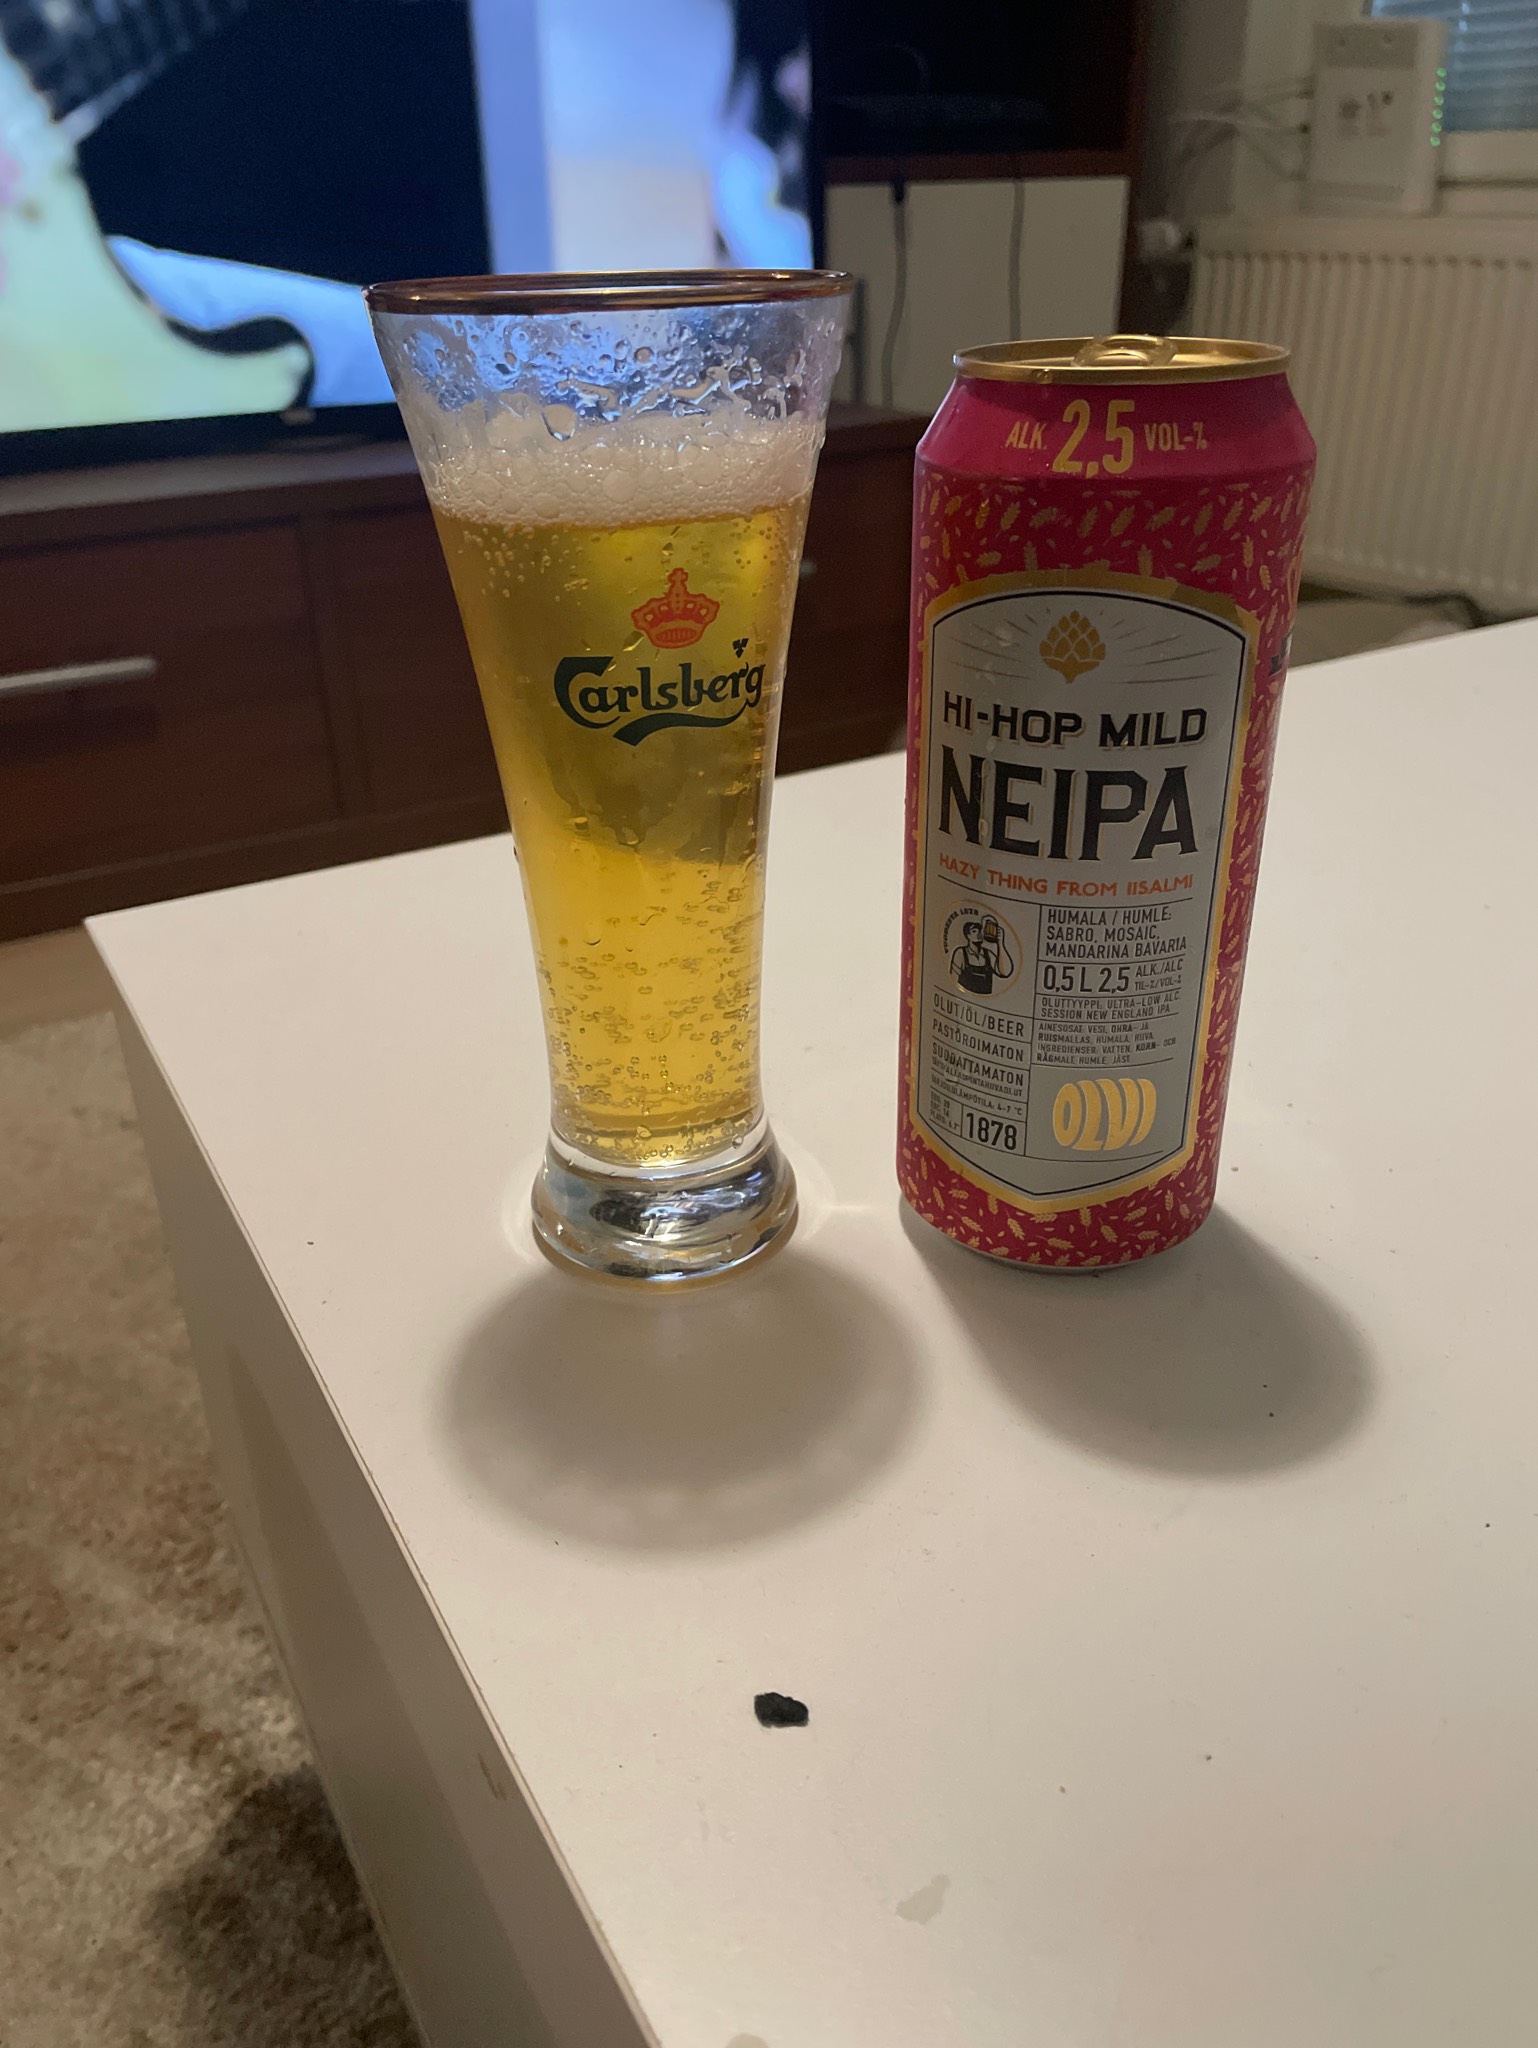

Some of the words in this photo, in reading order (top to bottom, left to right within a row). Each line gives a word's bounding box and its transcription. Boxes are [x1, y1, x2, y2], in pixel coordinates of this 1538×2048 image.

[1052, 400, 1135, 478] 2,5
[1144, 421, 1207, 451] VOL-%
[554, 655, 766, 746] Carlsberg
[943, 690, 1083, 745] HI-HOP
[1098, 708, 1207, 747] MILD
[938, 744, 1198, 861] NEIPA
[940, 853, 980, 880] HAZY
[987, 869, 1048, 894] THING
[1056, 881, 1117, 896] FROM
[1127, 873, 1194, 896] IISALMI
[1046, 926, 1098, 943] SABRO,
[1104, 925, 1160, 943] MOSAIC,
[1047, 908, 1107, 926] HUMALA
[1122, 906, 1172, 925] HUMLE:
[1045, 942, 1129, 959] MANDARINA
[1134, 936, 1187, 957] BAVARIA
[1043, 964, 1075, 993] 0,5
[1080, 967, 1092, 992] L
[1098, 966, 1131, 994] 2,5
[934, 993, 1024, 1037] OLUT/ÖL/BEER
[1041, 1009, 1082, 1020] SESSION
[1086, 1009, 1108, 1020] NEW
[1111, 1007, 1153, 1020] ENGLAND
[1157, 1004, 1170, 1014] IPA
[1107, 994, 1161, 1010] ULTRA-LOW
[932, 1018, 1024, 1062] PASTÖROIMATON
[932, 1042, 1024, 1087] SUODATTAMATON
[966, 1112, 1018, 1151] 1878
[1053, 1078, 1157, 1151] OLVI
